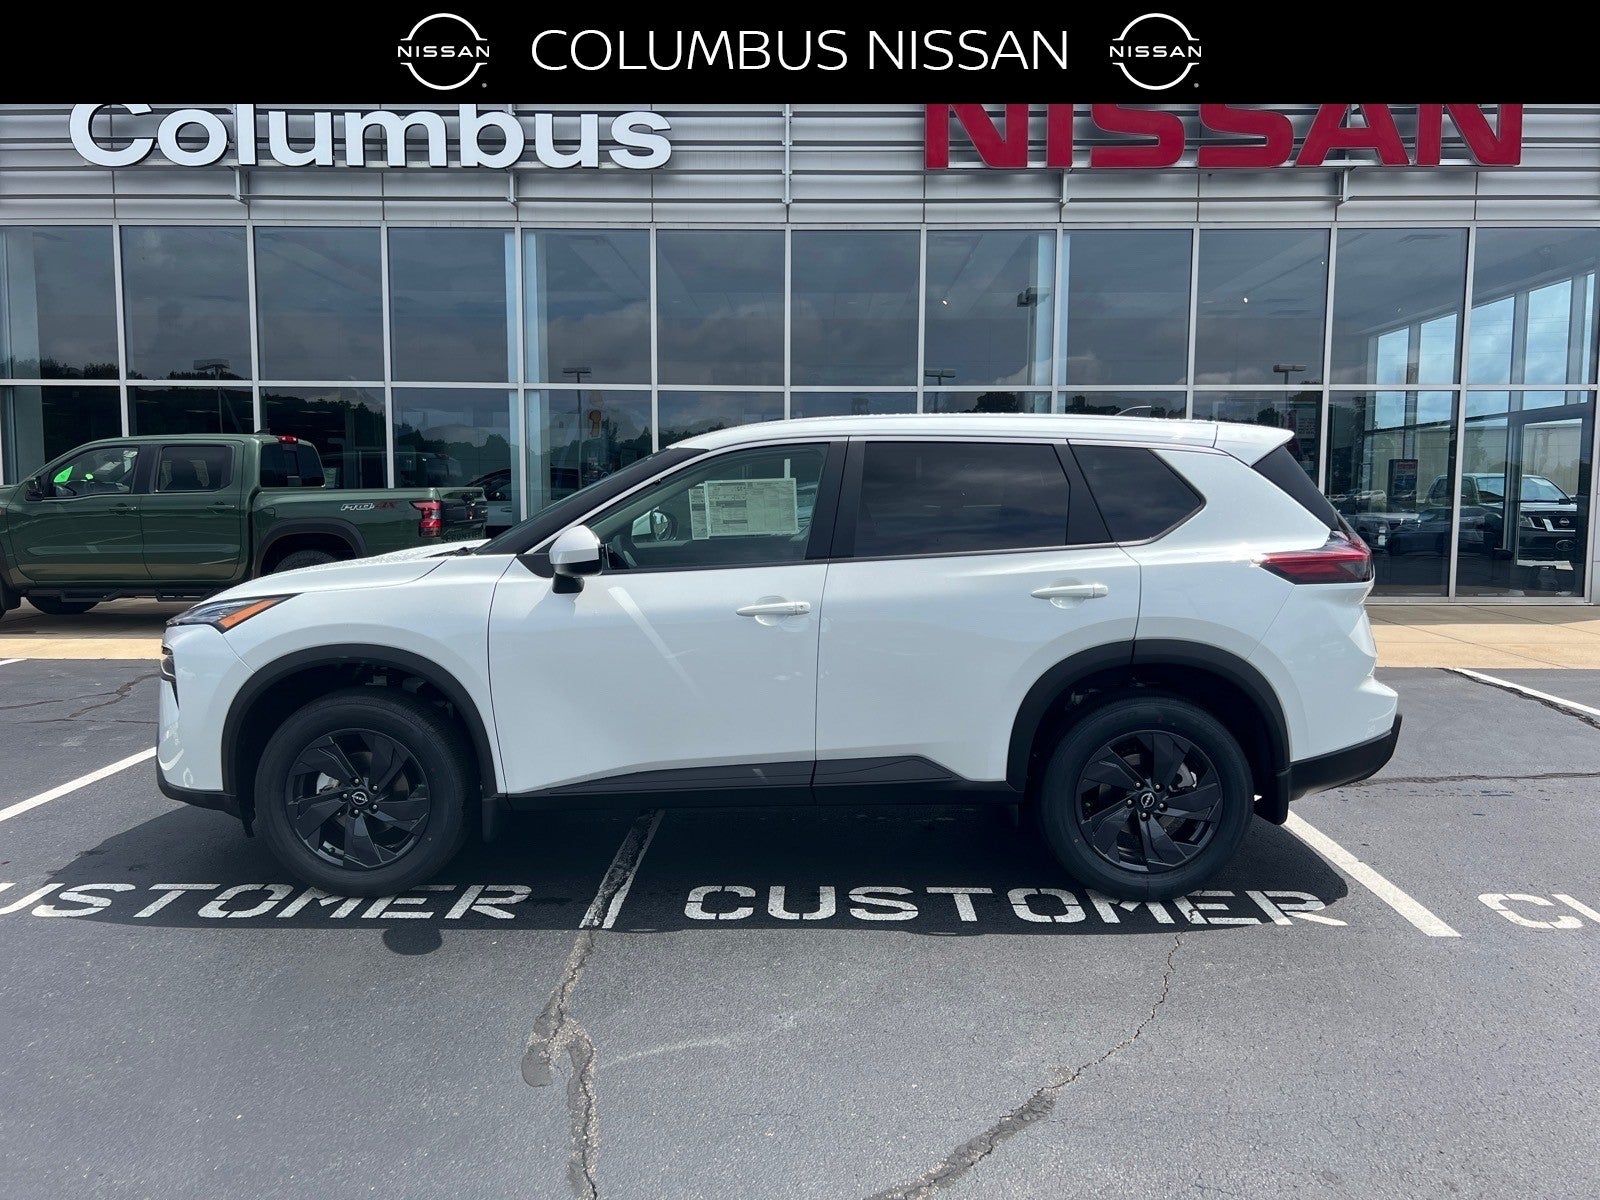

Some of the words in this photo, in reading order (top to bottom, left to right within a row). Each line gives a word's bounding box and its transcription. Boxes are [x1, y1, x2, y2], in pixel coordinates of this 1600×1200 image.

[69, 103, 674, 170] Columbus
[924, 103, 1524, 169] NISSAN
[684, 885, 1349, 926] CUSTOMER
